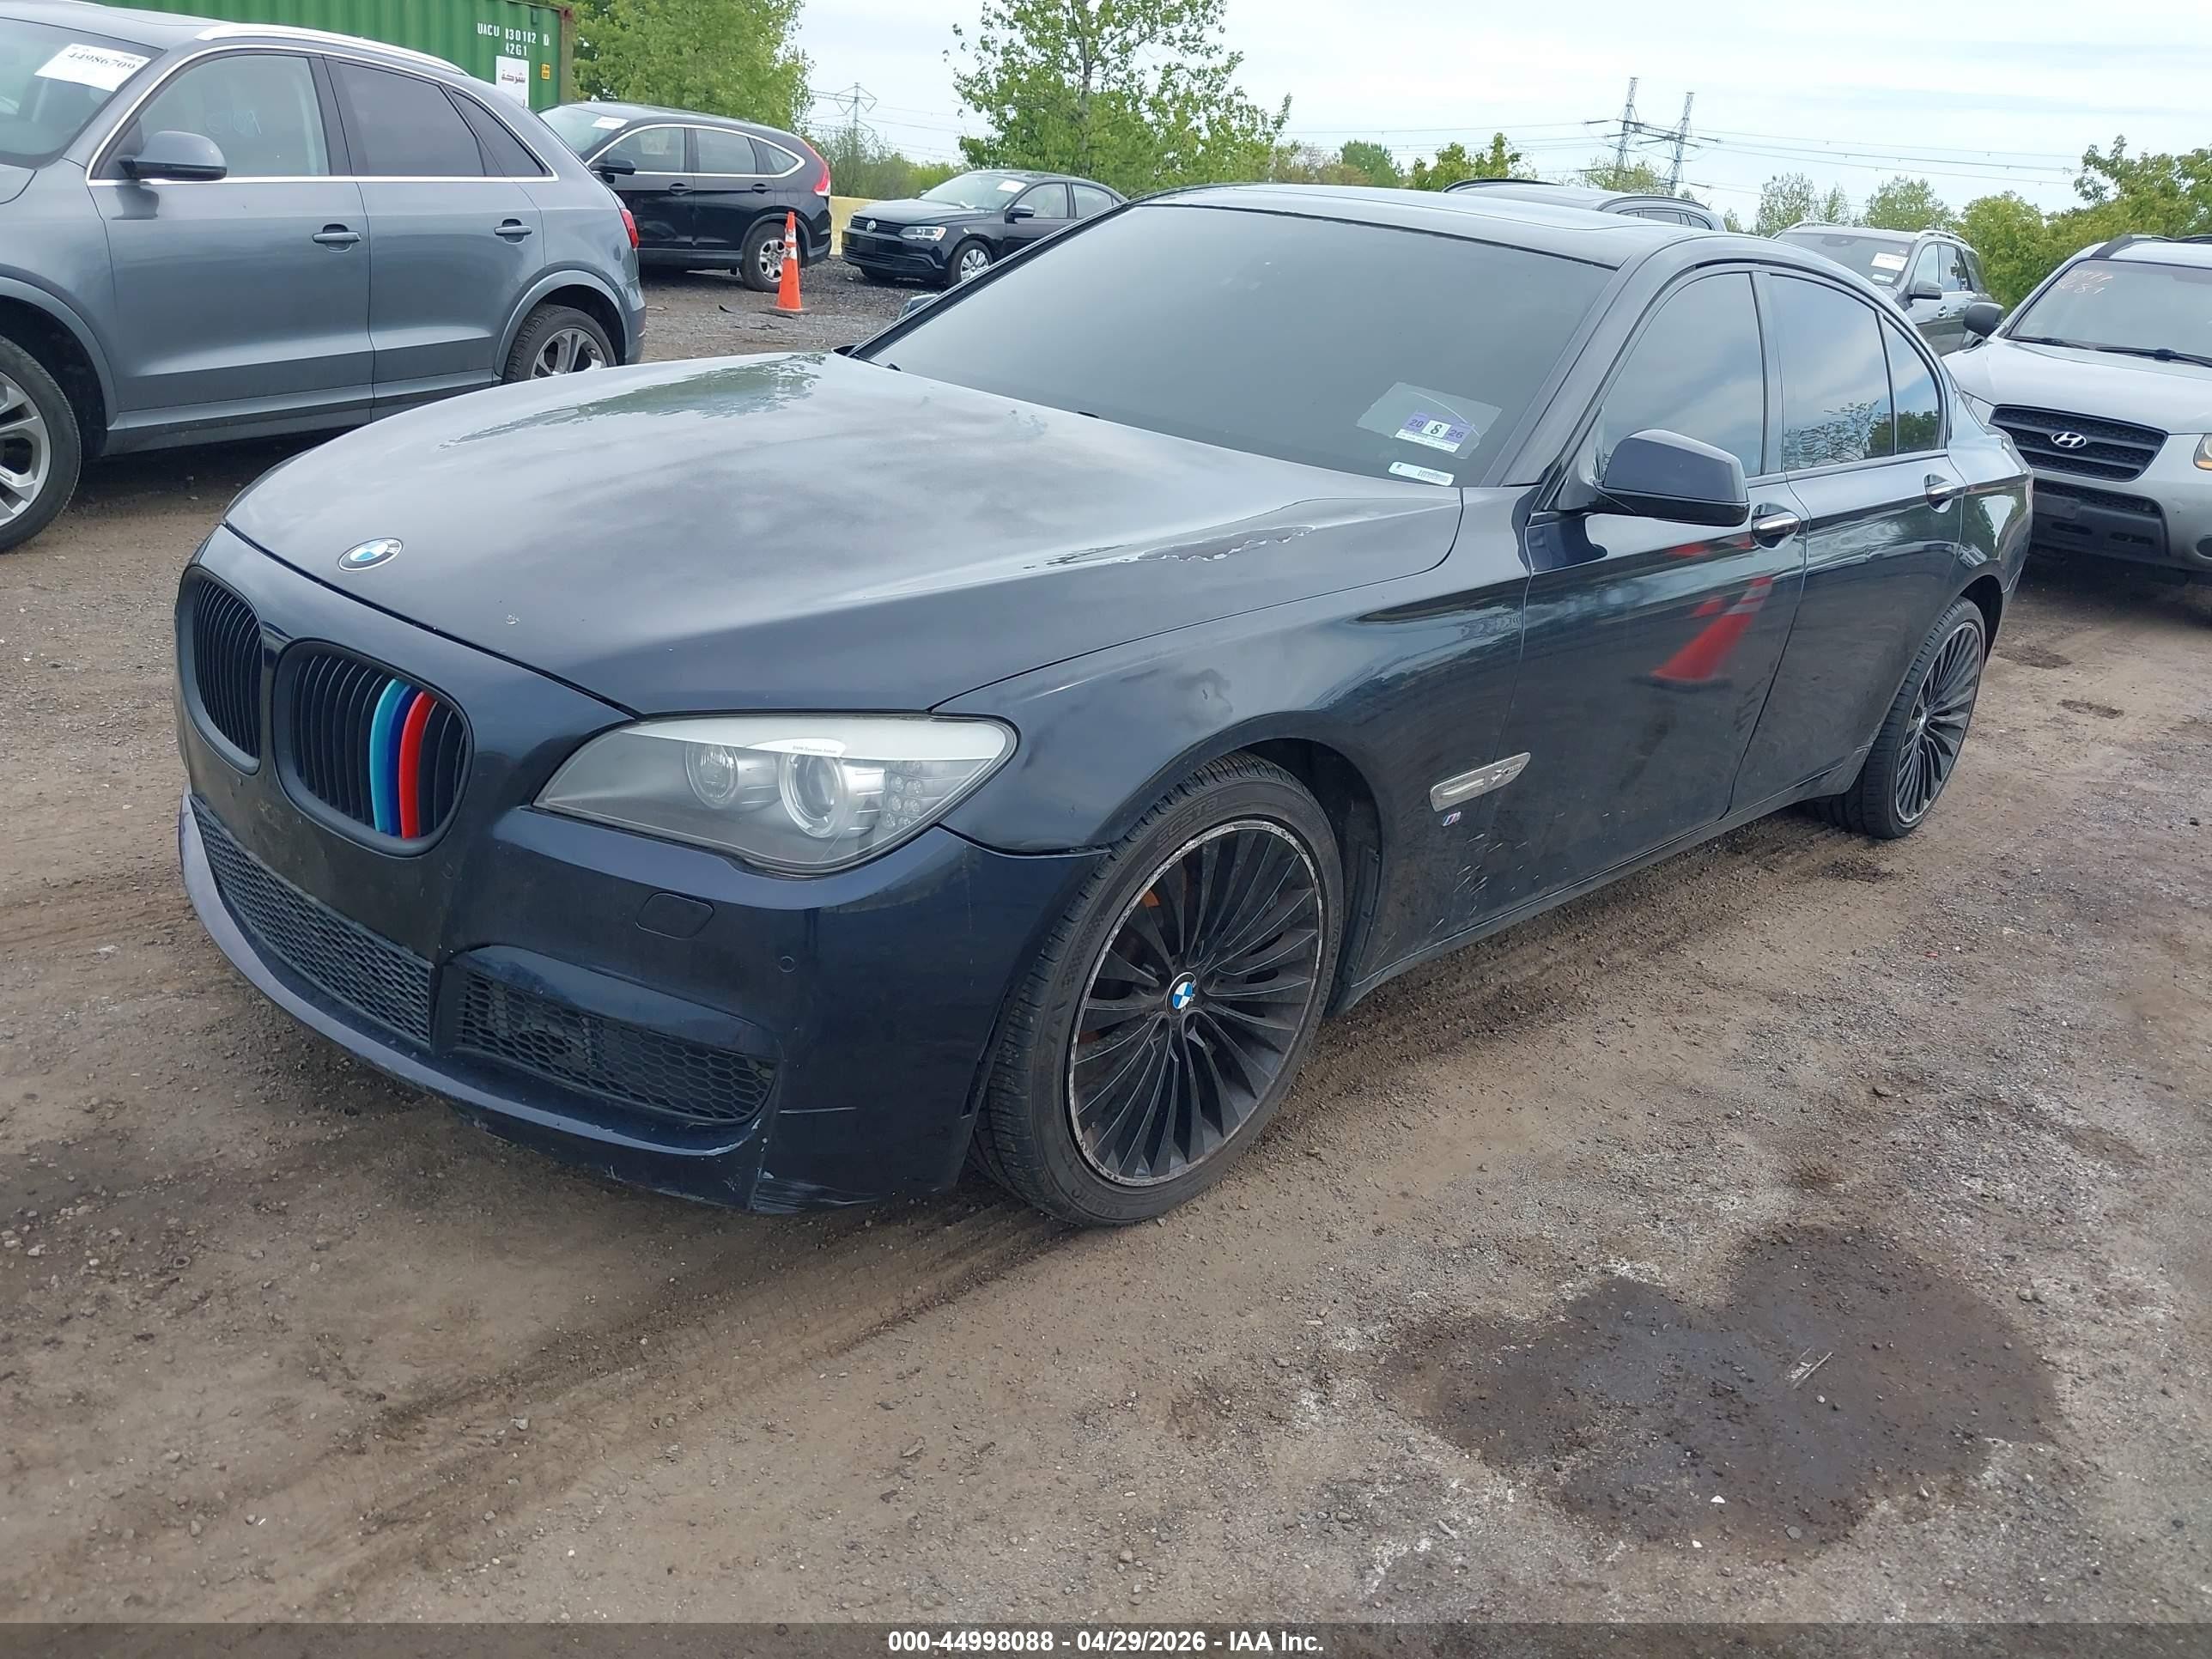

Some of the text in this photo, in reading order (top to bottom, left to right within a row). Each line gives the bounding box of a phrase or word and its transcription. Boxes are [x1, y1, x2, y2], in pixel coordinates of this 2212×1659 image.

[477, 22, 500, 37] UACU
[505, 42, 527, 57] 42G1
[67, 52, 137, 70] 44986709
[1408, 418, 1425, 428] 20
[1448, 429, 1465, 439] 26
